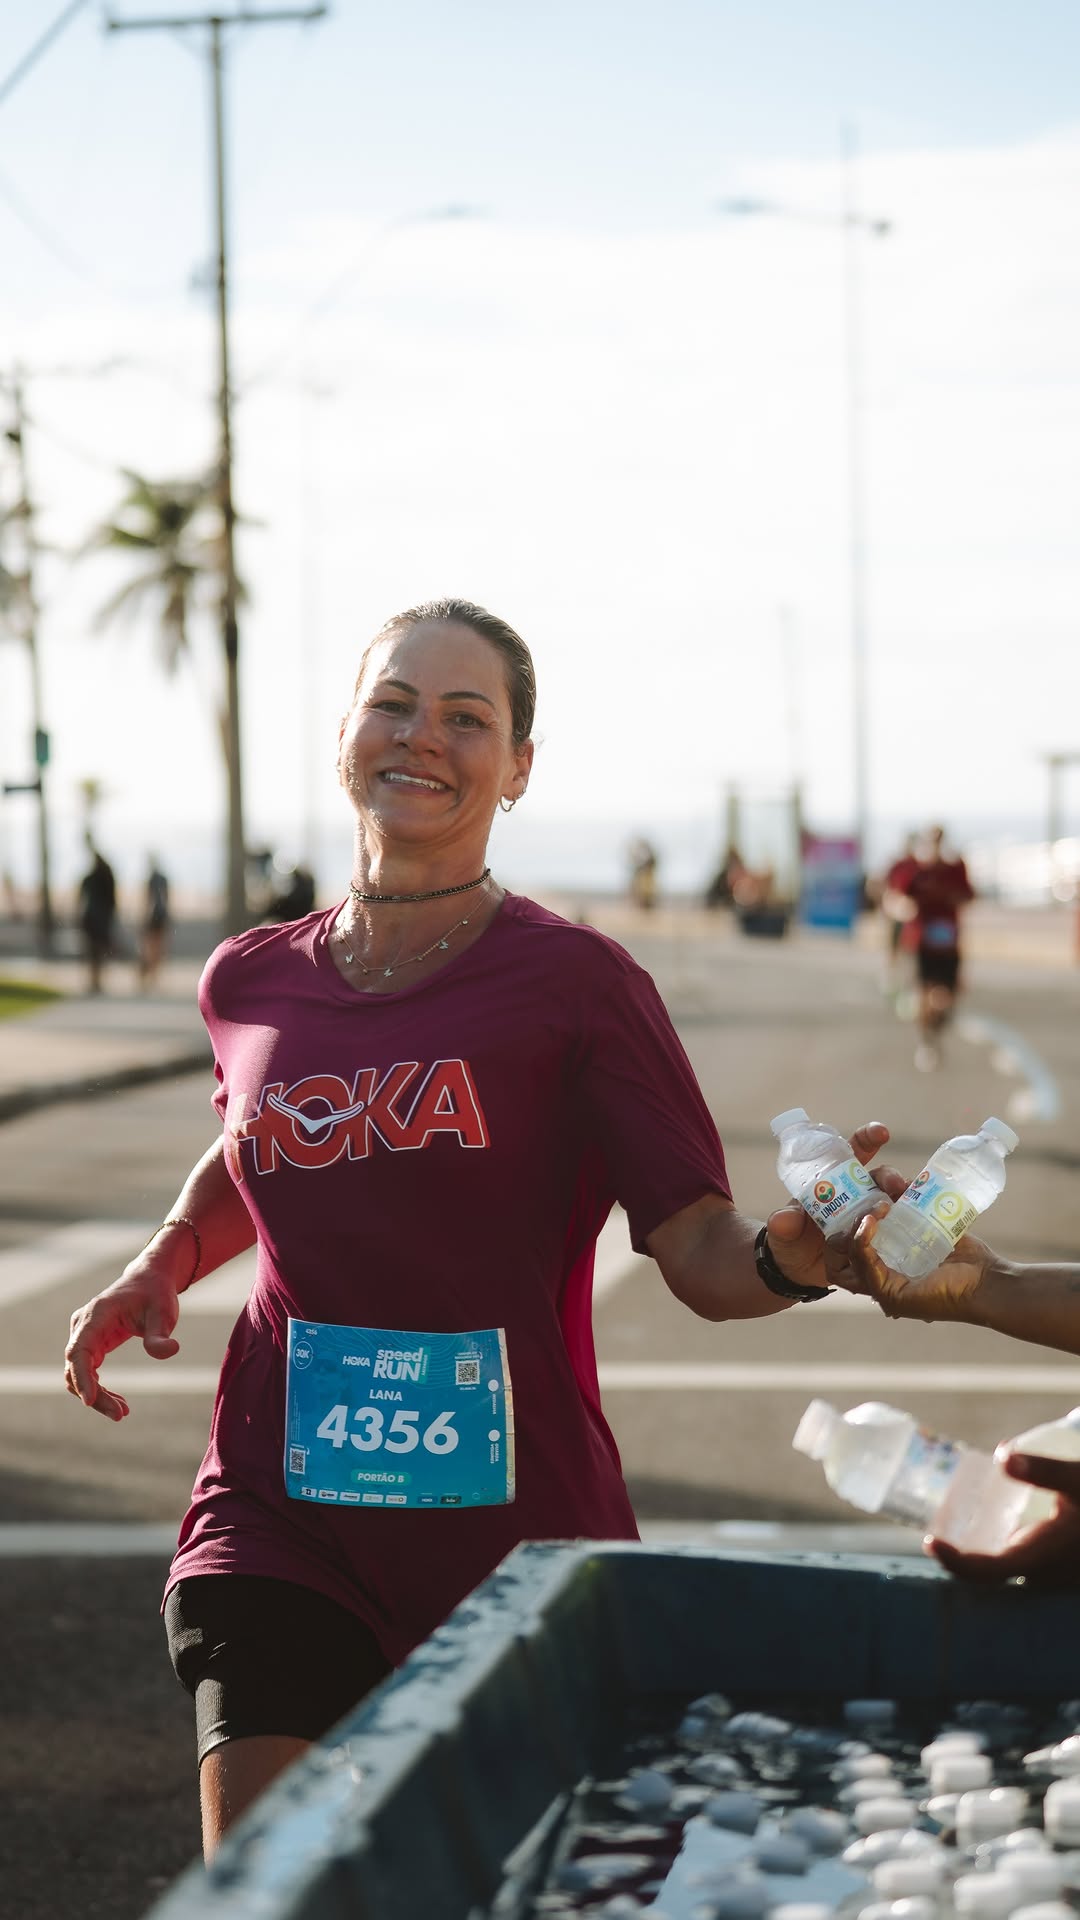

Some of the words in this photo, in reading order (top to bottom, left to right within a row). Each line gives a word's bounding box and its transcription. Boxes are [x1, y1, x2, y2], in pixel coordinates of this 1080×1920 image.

[229, 1059, 491, 1184] HOKA
[295, 1348, 310, 1359] 30K
[376, 1347, 424, 1362] speed
[342, 1356, 371, 1368] HOKA
[372, 1359, 421, 1382] RUN
[369, 1389, 403, 1401] LANA
[316, 1404, 460, 1455] 4356
[357, 1472, 396, 1484] PORTÃO
[397, 1475, 405, 1483] B
